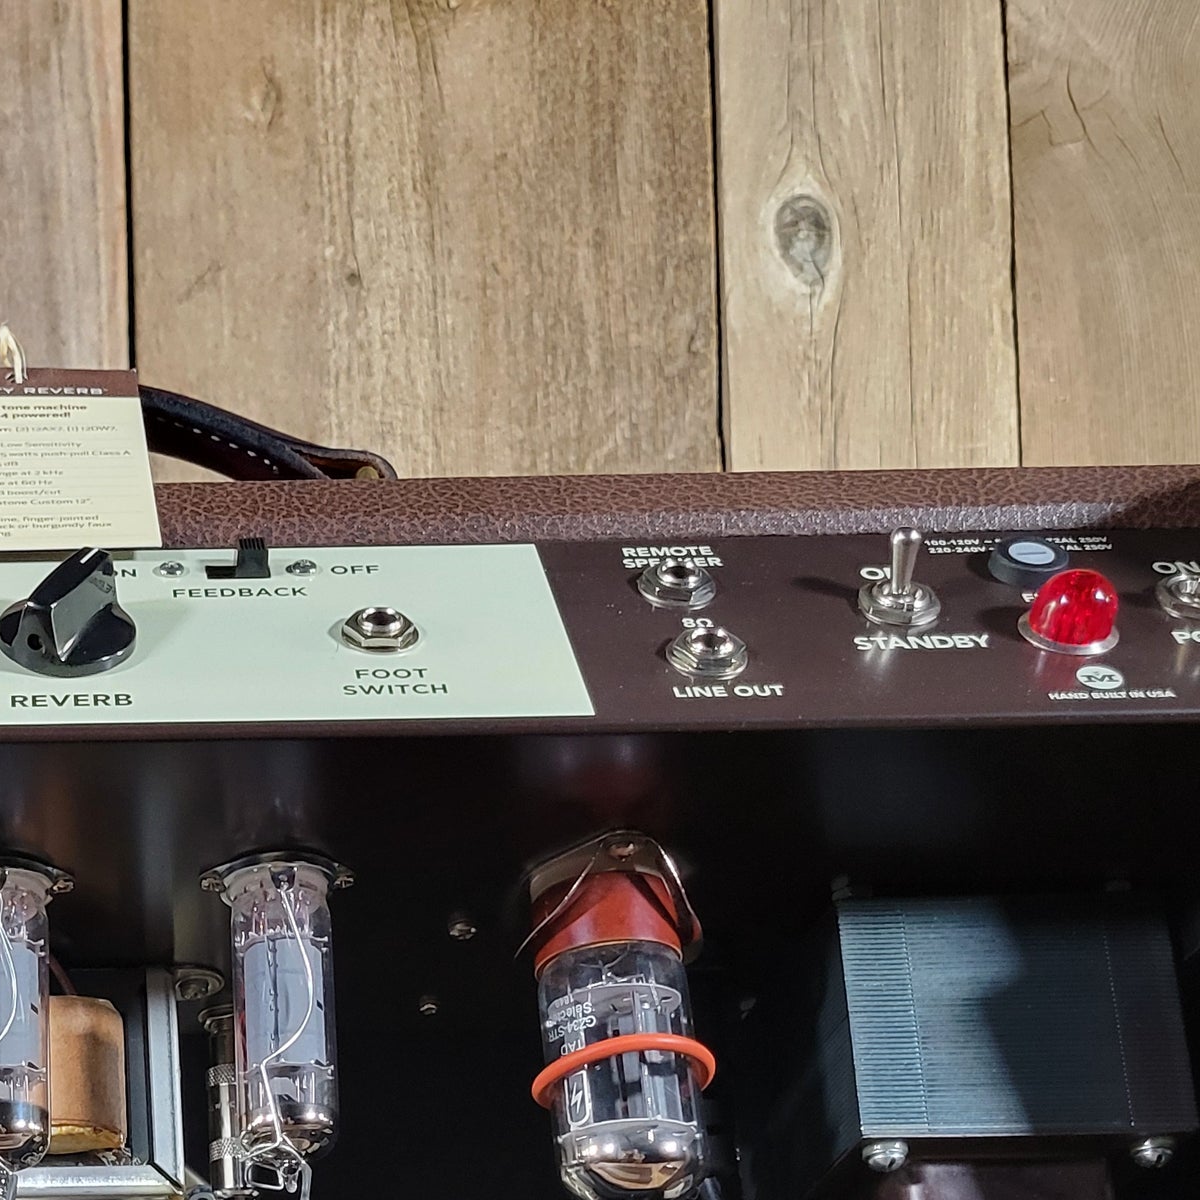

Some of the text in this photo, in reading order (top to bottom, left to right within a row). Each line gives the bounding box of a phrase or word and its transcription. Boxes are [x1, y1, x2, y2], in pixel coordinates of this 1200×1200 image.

[24, 387, 103, 395] REVERB
[924, 538, 980, 546] 100-120V
[1078, 536, 1108, 544] 250V
[621, 546, 714, 557] REMOTE
[928, 546, 986, 554] 220-240V
[1083, 543, 1113, 551] 250V
[622, 557, 724, 569] SPEER
[330, 564, 380, 575] OFF
[172, 585, 308, 599] FEEDBACK
[853, 635, 989, 651] STANDBY
[354, 668, 428, 680] FOOT
[342, 682, 449, 697] SWITCH
[672, 684, 785, 698] LINE OUT
[1049, 689, 1178, 700] HAND BUILT IN USA
[9, 692, 134, 709] REVERB
